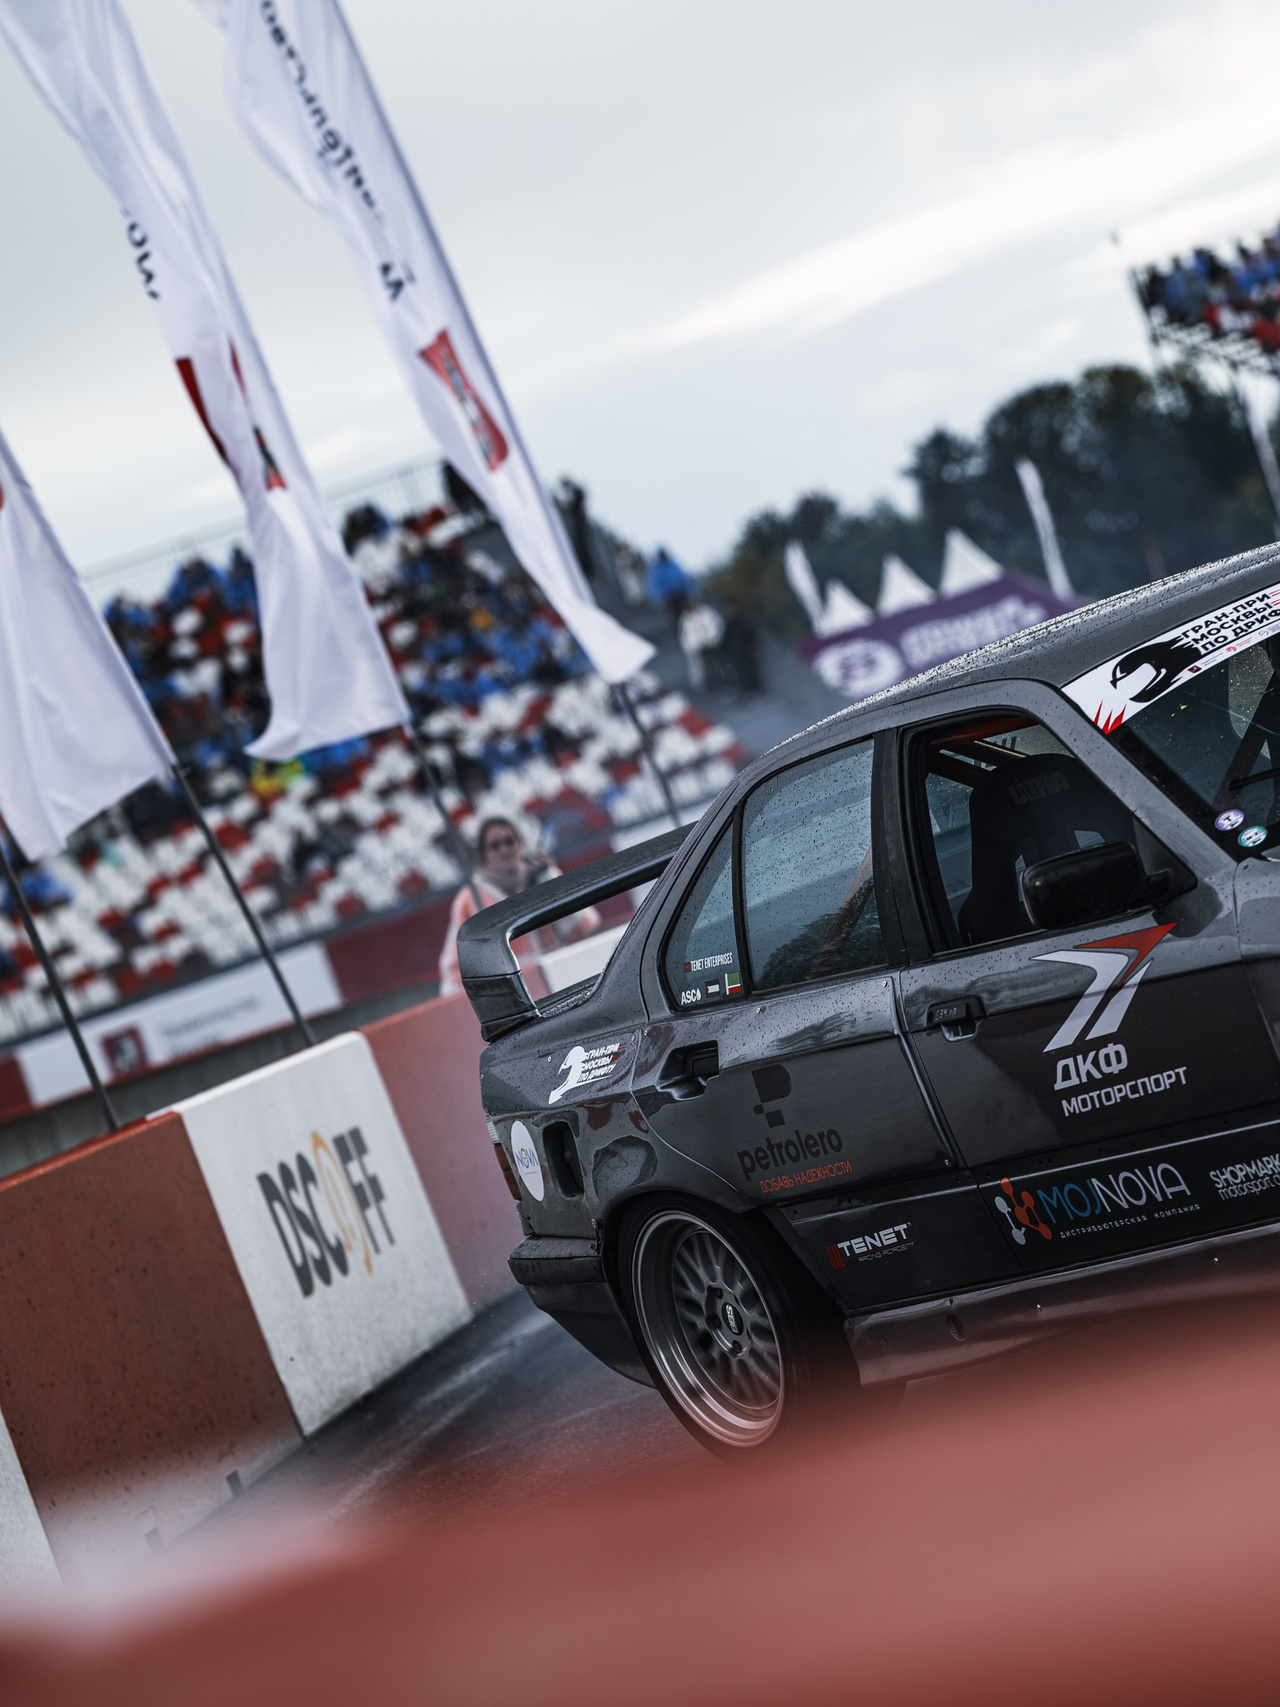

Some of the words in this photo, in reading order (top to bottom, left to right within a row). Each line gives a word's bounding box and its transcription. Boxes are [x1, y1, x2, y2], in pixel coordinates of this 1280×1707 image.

[1182, 593, 1271, 638] ГРАН-ПРИ
[1192, 602, 1273, 644] МОСКВЫ
[1201, 635, 1228, 652] ПО
[691, 958, 704, 971] TENET
[704, 952, 733, 969] ENTERPRISES
[1054, 1043, 1128, 1090] ДКФ
[1061, 1066, 1187, 1117] МОТОРСПОРТ
[737, 1128, 842, 1181] petrolero
[760, 1175, 794, 1193] ДОБАВЬ
[793, 1160, 853, 1185] НАДЕЖНОСТИ
[1036, 1163, 1191, 1224] MOJNOVA
[1218, 1175, 1275, 1200] motorsport
[1154, 1204, 1200, 1219] КОМПАНИЯ
[837, 1223, 908, 1256] TENET
